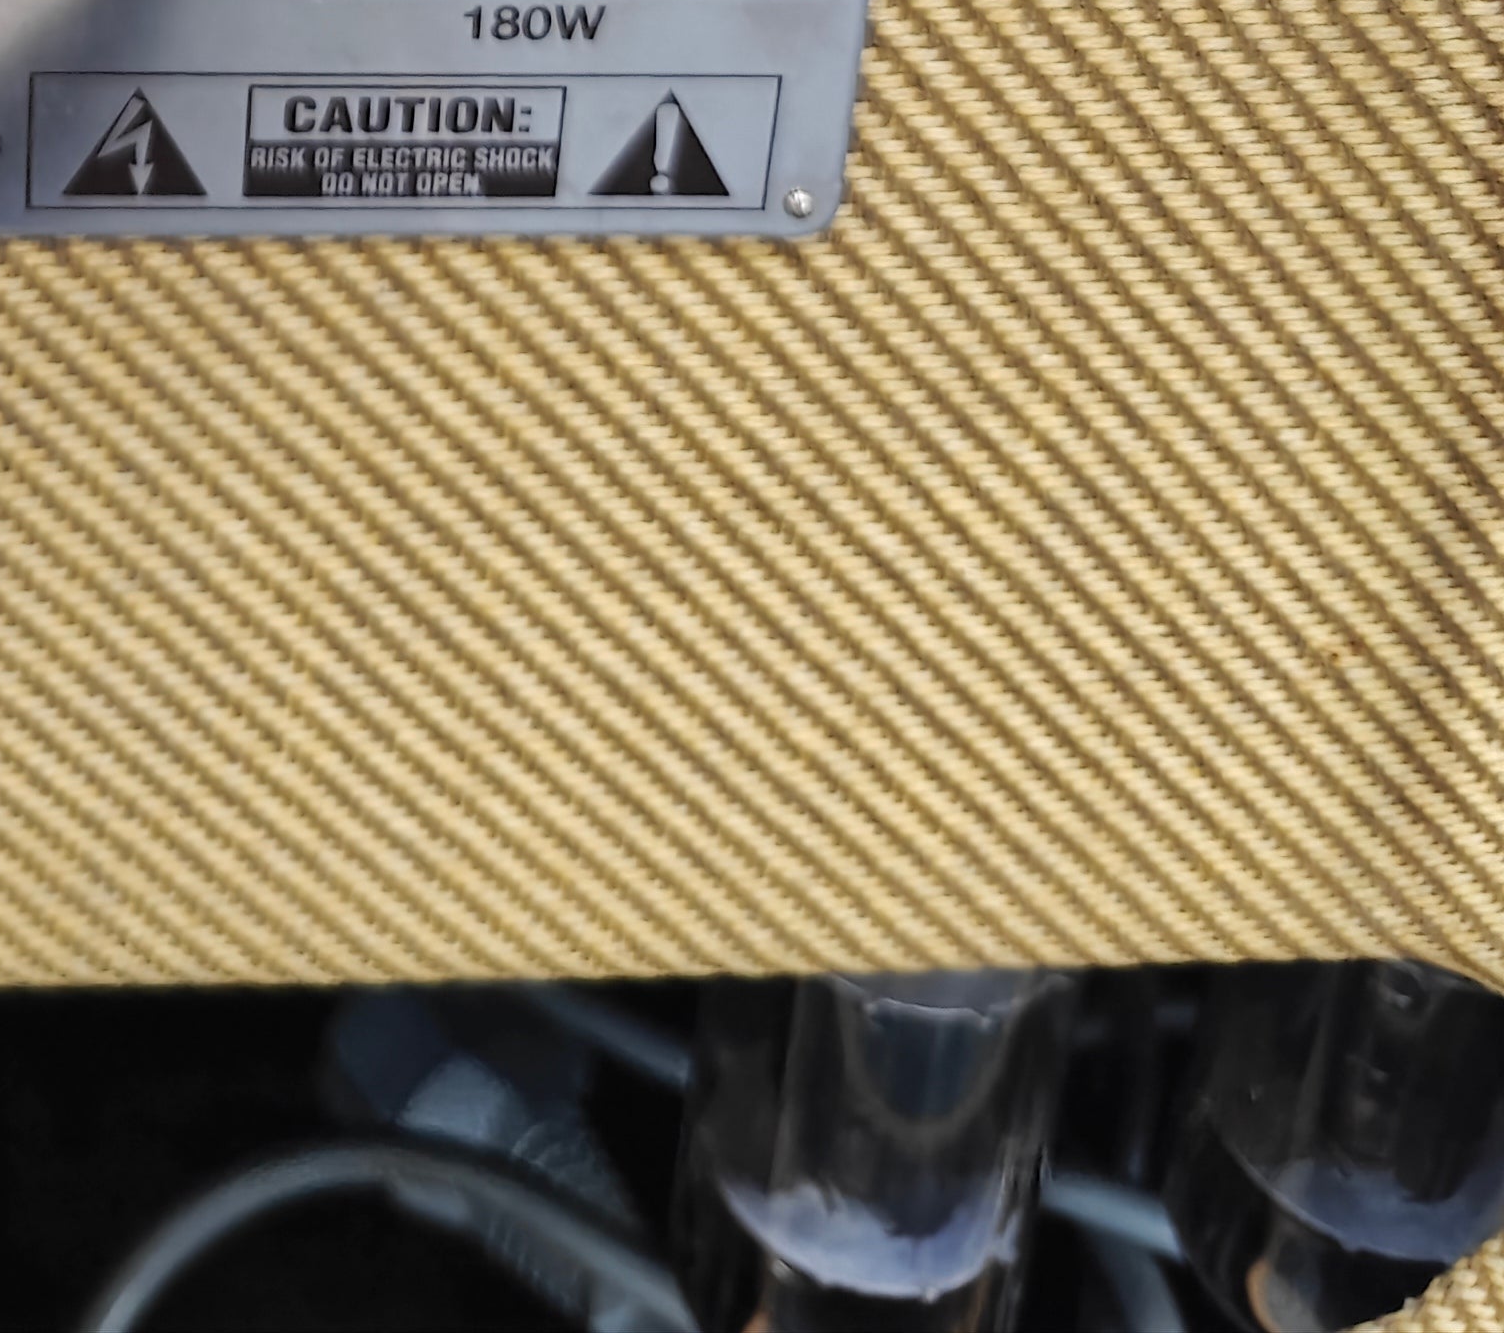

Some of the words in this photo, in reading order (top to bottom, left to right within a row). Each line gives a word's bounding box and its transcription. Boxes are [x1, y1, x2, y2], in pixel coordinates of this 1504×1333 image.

[464, 5, 607, 41] 180W
[283, 95, 532, 133] CAUTION:
[250, 146, 306, 169] RISK
[314, 146, 345, 169] OF
[352, 146, 468, 170] ELECTRIC
[474, 146, 554, 170] SHOCK
[321, 172, 354, 196] DO
[360, 172, 404, 196] NOT
[415, 172, 480, 196] OPEN
